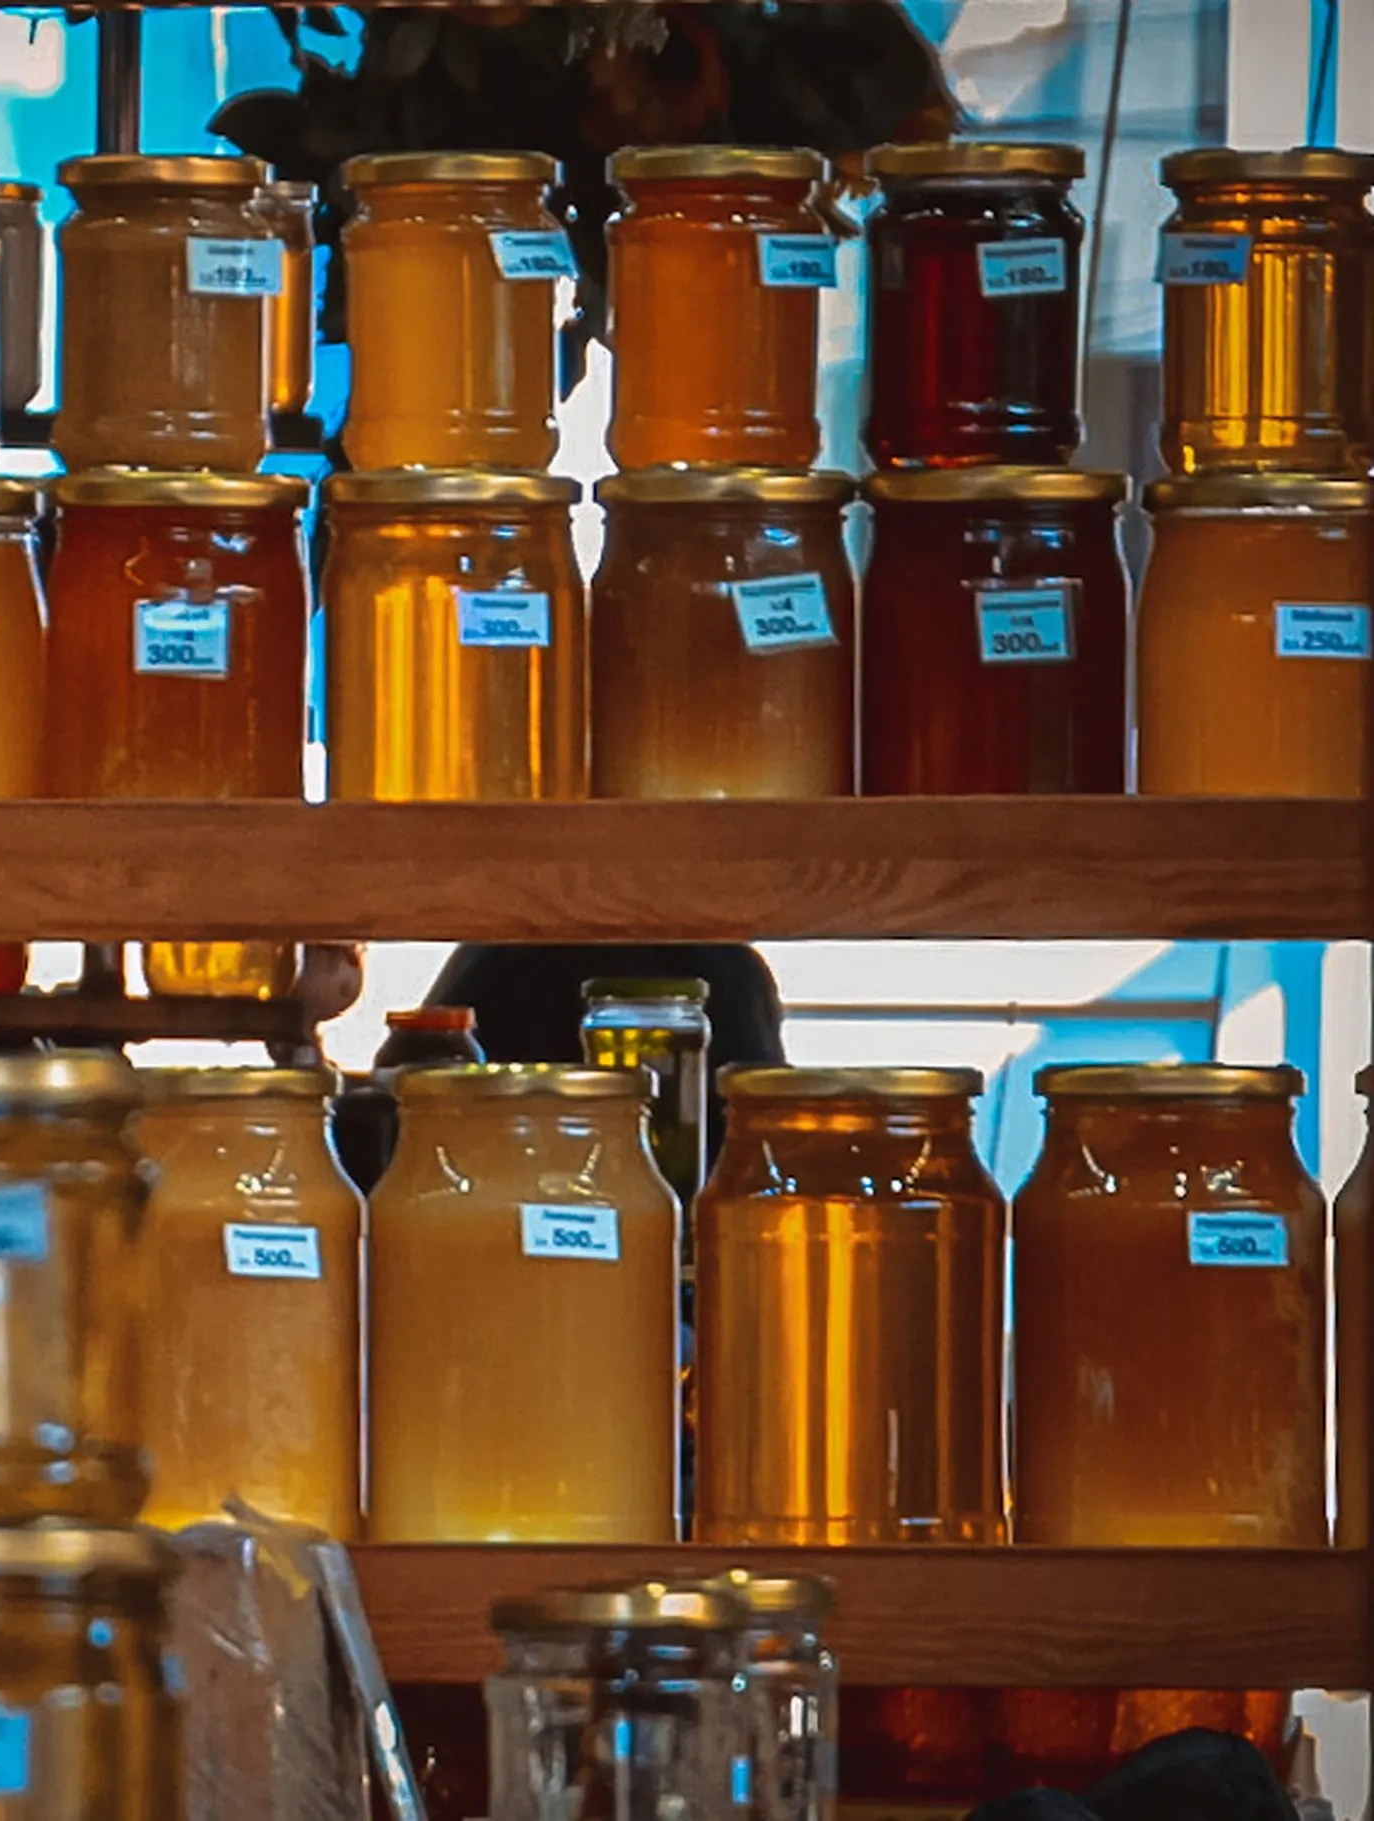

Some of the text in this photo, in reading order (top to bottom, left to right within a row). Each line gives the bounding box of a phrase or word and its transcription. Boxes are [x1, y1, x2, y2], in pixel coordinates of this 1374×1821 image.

[755, 615, 797, 637] 300
[992, 631, 1041, 653] 300
[1303, 630, 1343, 651] 250
[146, 643, 195, 665] 300
[552, 1228, 592, 1248] 500
[253, 1247, 292, 1266] 500
